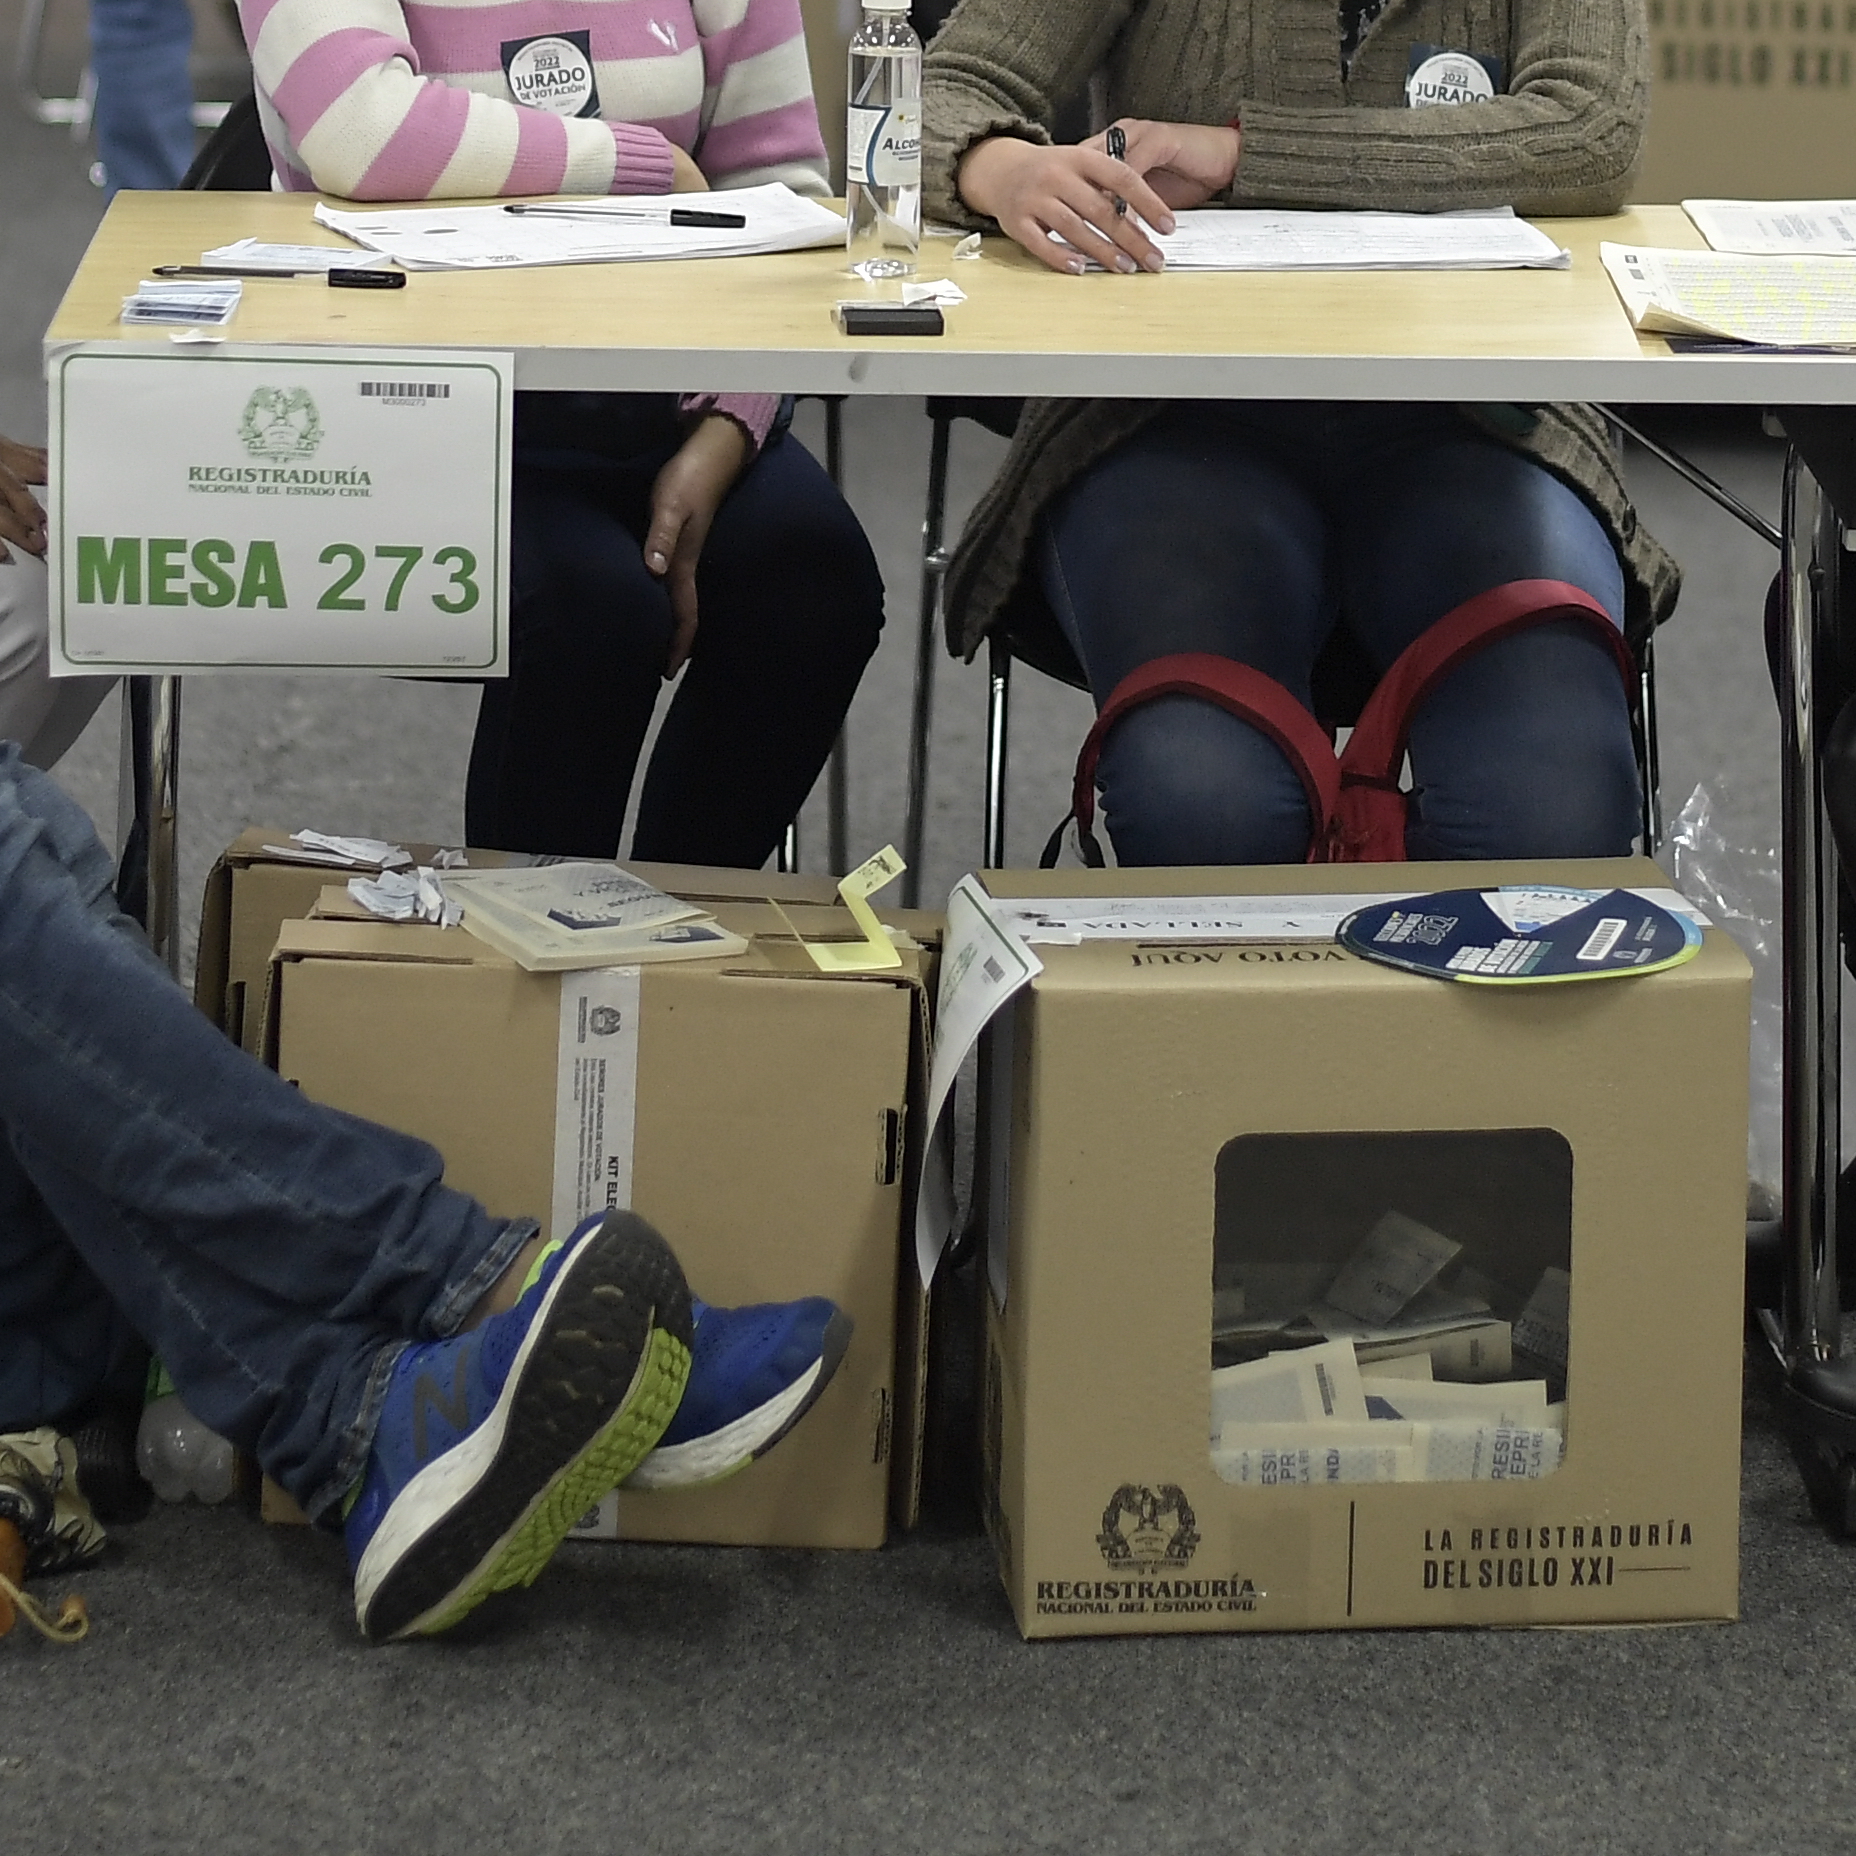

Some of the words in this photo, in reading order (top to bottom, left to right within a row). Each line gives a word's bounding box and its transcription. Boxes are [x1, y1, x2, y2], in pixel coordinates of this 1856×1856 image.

[534, 56, 560, 68] 2022
[515, 67, 585, 91] JURADO
[1441, 72, 1469, 84] 2022
[520, 92, 531, 100] DE
[532, 84, 586, 99] VOTACIÓN
[188, 465, 371, 485] REGISTRADURÍA
[188, 484, 251, 494] NACIONAL
[257, 485, 281, 495] DEL
[286, 486, 336, 496] ESTADO
[339, 487, 372, 497] CIVIL
[77, 536, 288, 609] MESA
[316, 542, 480, 614] 273
[1240, 951, 1347, 963] VOTO
[608, 1156, 619, 1178] KIT
[1424, 1529, 1452, 1551] LA
[1471, 1519, 1693, 1550] REGISTRADURÍA
[1423, 1559, 1471, 1589] DEL
[1478, 1557, 1559, 1588] SIGLO
[1570, 1556, 1614, 1587] XXI
[1037, 1572, 1257, 1599] REGISTRADURÍA
[1037, 1601, 1112, 1614] NACIONAL
[1118, 1601, 1149, 1613] DEL
[1153, 1600, 1213, 1613] ESTADO
[1217, 1599, 1257, 1611] CIVIL
